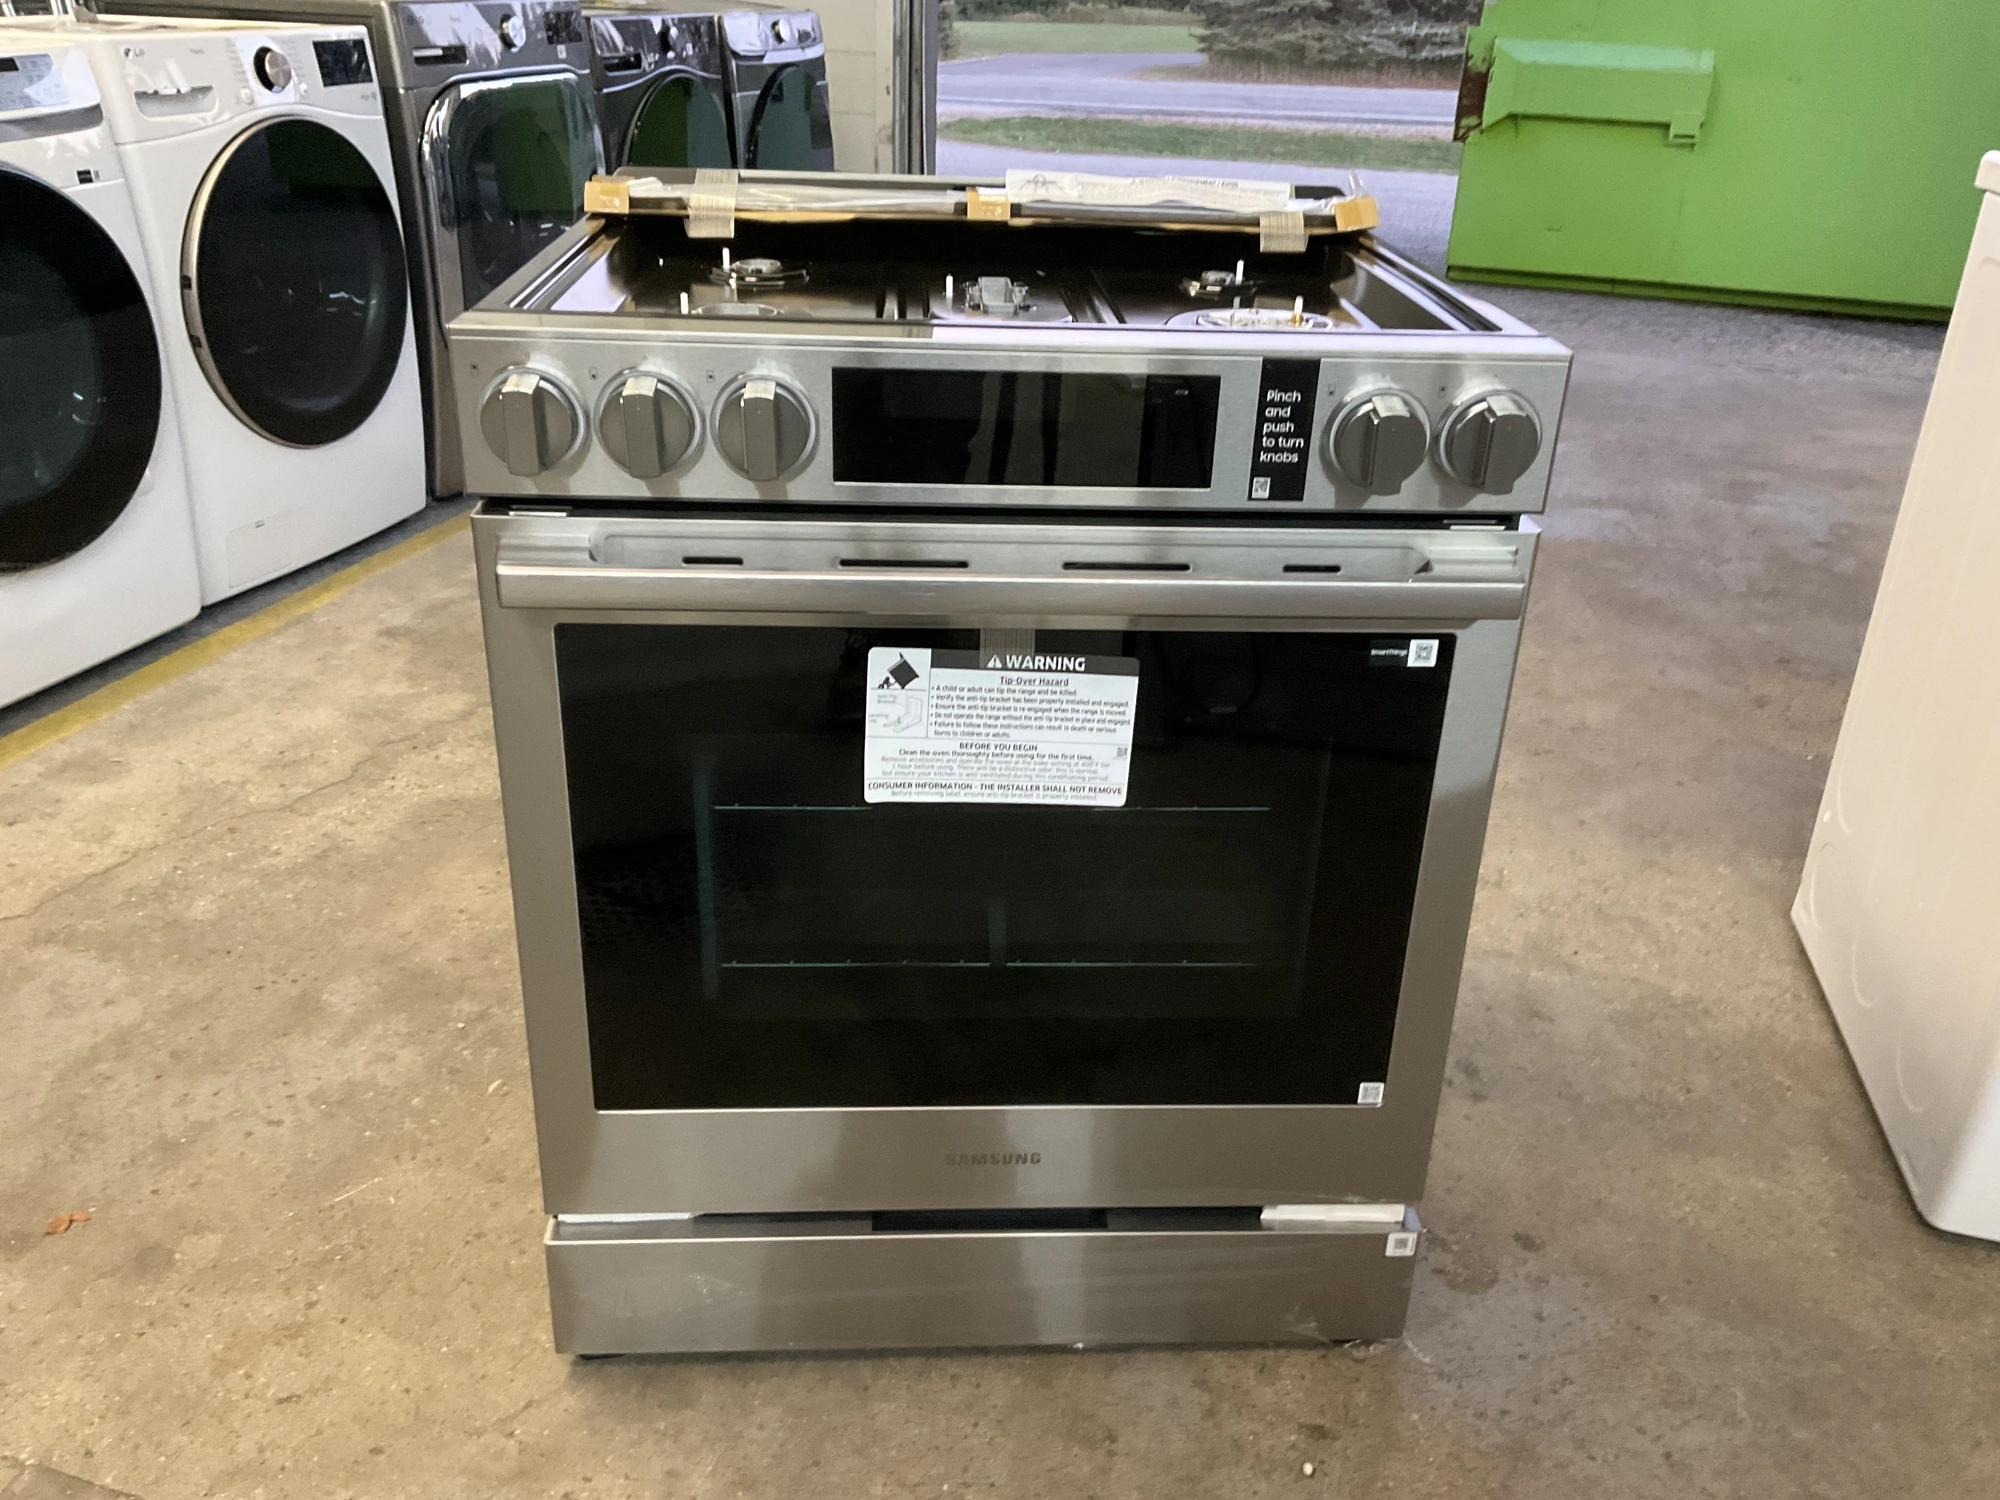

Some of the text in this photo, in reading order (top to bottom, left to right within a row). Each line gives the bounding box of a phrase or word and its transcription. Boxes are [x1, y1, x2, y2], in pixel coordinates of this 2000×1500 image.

[1266, 388, 1301, 403] Pinch
[1265, 405, 1291, 418] and
[1263, 421, 1294, 435] push
[1262, 436, 1304, 448] to turn
[1259, 450, 1299, 463] knobs
[1006, 654, 1086, 672] WARNING
[1039, 678, 1069, 686] Hazard
[959, 742, 991, 750] BEFORE
[868, 782, 913, 790] CONSUMER
[915, 782, 972, 790] INFORMATION
[997, 784, 1040, 792] INSTALLER
[1043, 784, 1067, 792] SHALL
[1069, 785, 1086, 793] NOT
[1088, 786, 1122, 794] REMOVE
[946, 1152, 1041, 1166] SAMSUNG
